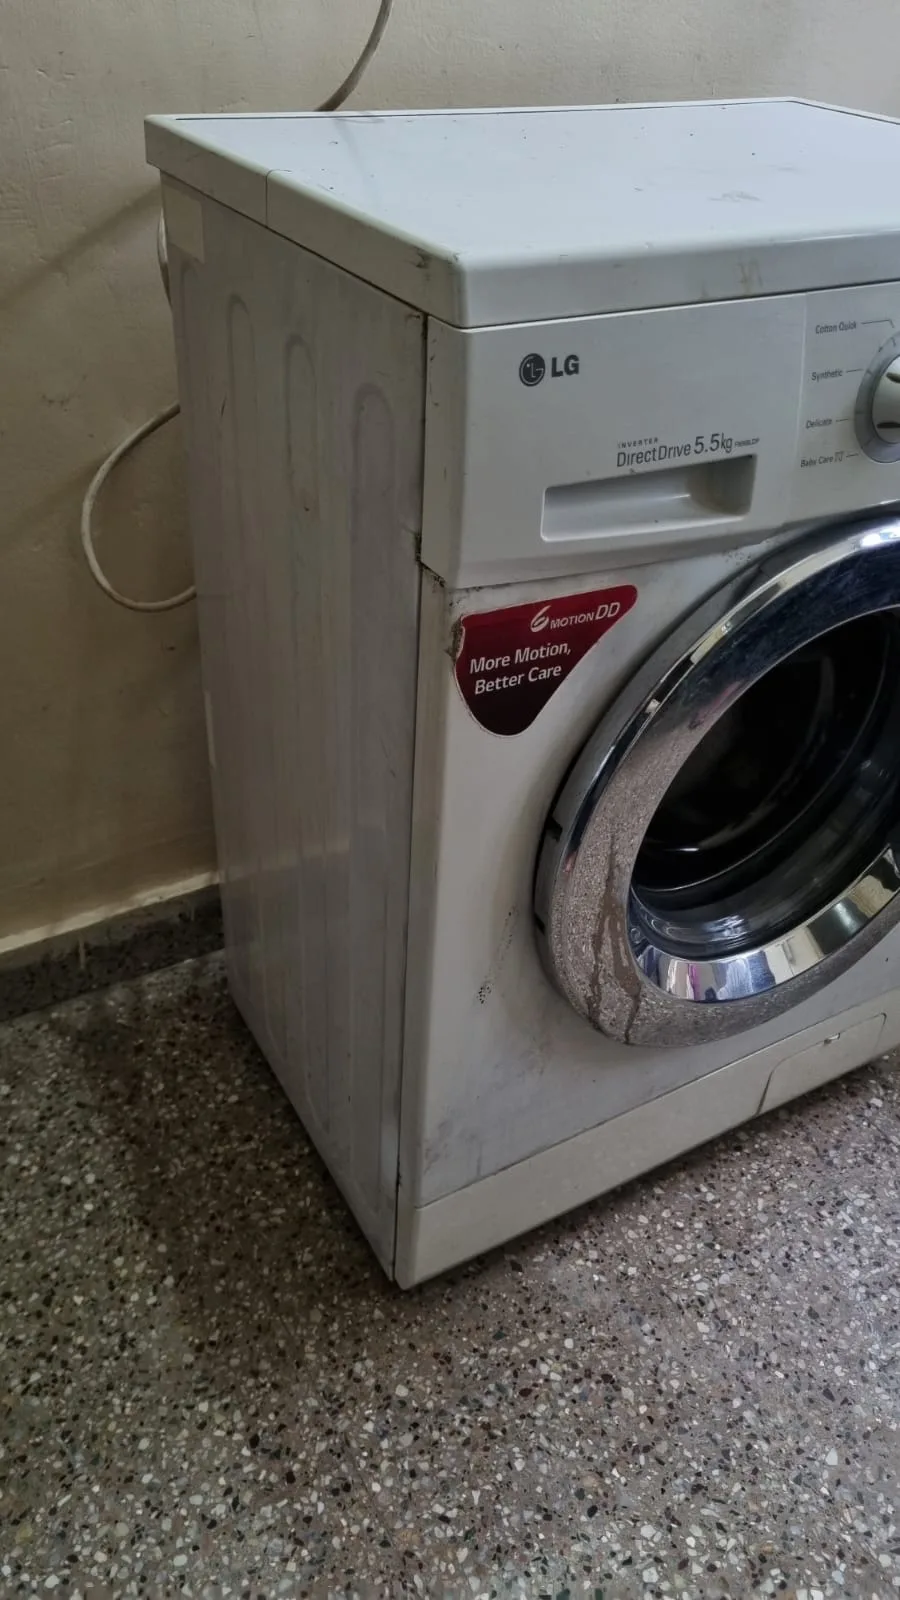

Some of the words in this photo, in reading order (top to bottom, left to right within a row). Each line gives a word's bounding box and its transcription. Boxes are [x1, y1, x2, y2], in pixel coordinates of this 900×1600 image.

[551, 354, 580, 378] LG
[811, 370, 843, 382] Synthetic
[617, 437, 659, 449] INVERTER
[693, 432, 734, 455] 5.5kg
[530, 604, 552, 633] 6
[550, 611, 596, 630] MOTION
[594, 601, 621, 621] DD
[469, 653, 511, 675] More
[514, 641, 572, 665] Motion,
[474, 673, 525, 696] Better
[527, 665, 562, 683] Care
